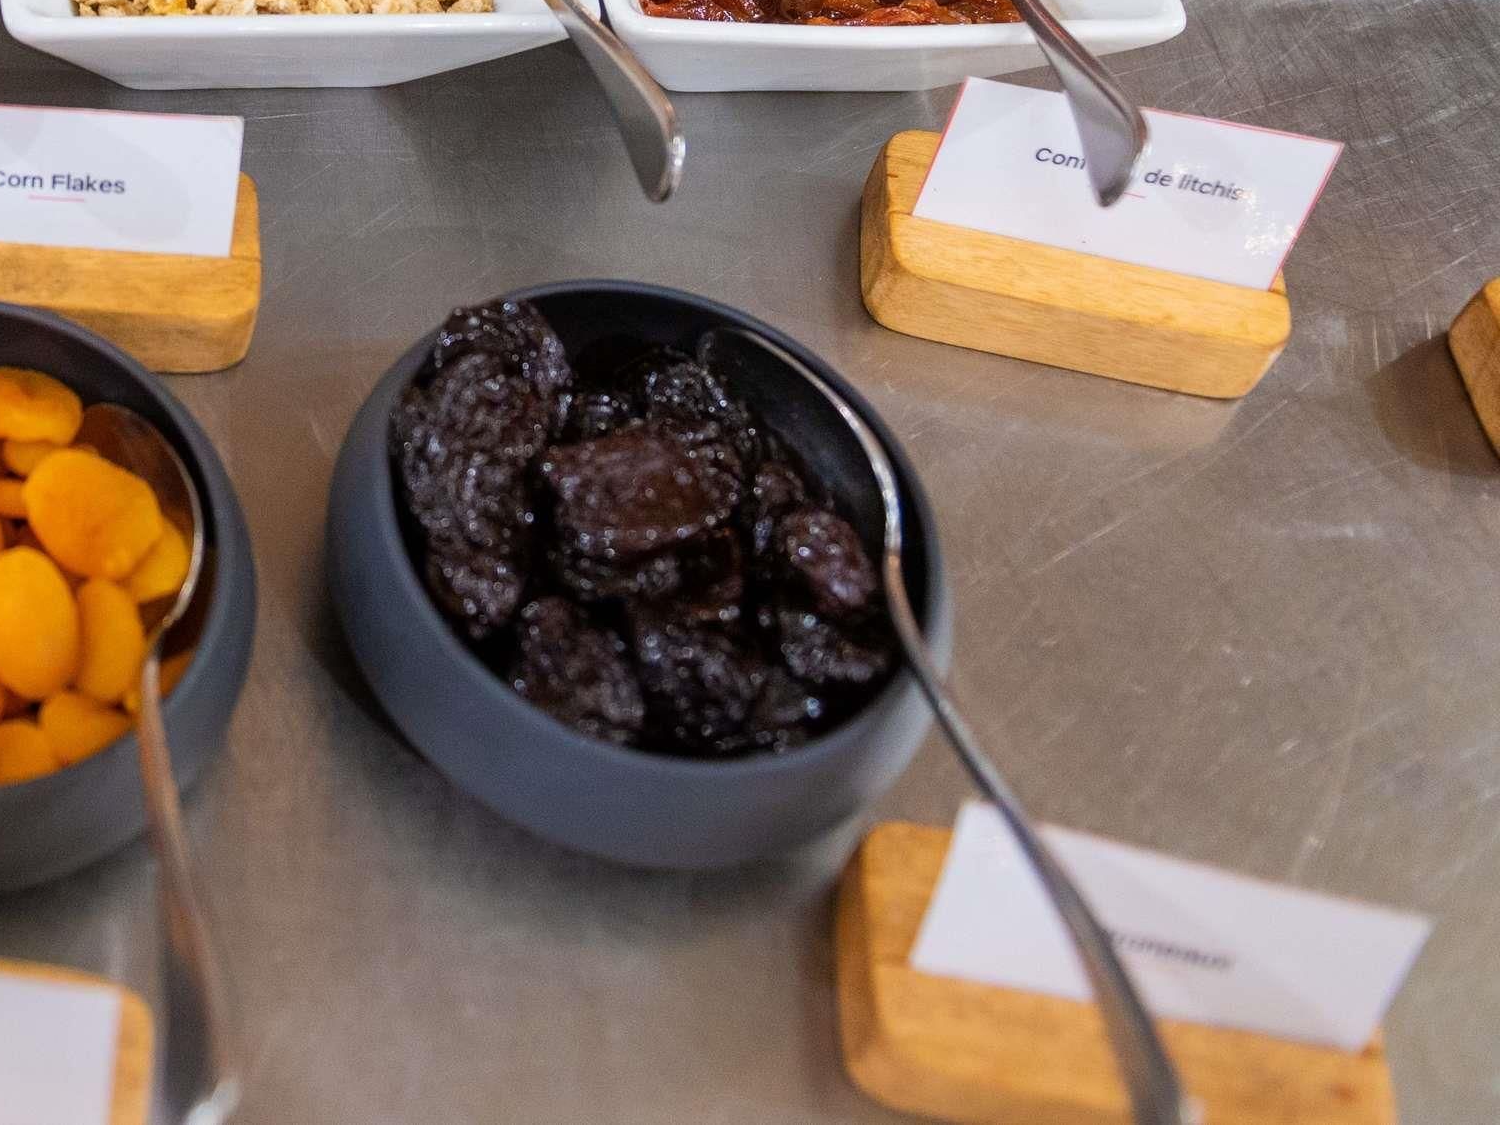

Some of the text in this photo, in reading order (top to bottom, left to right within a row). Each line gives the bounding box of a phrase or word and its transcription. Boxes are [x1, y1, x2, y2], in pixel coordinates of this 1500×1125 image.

[51, 173, 126, 195] Flakes
[1143, 169, 1244, 201] de litchis
